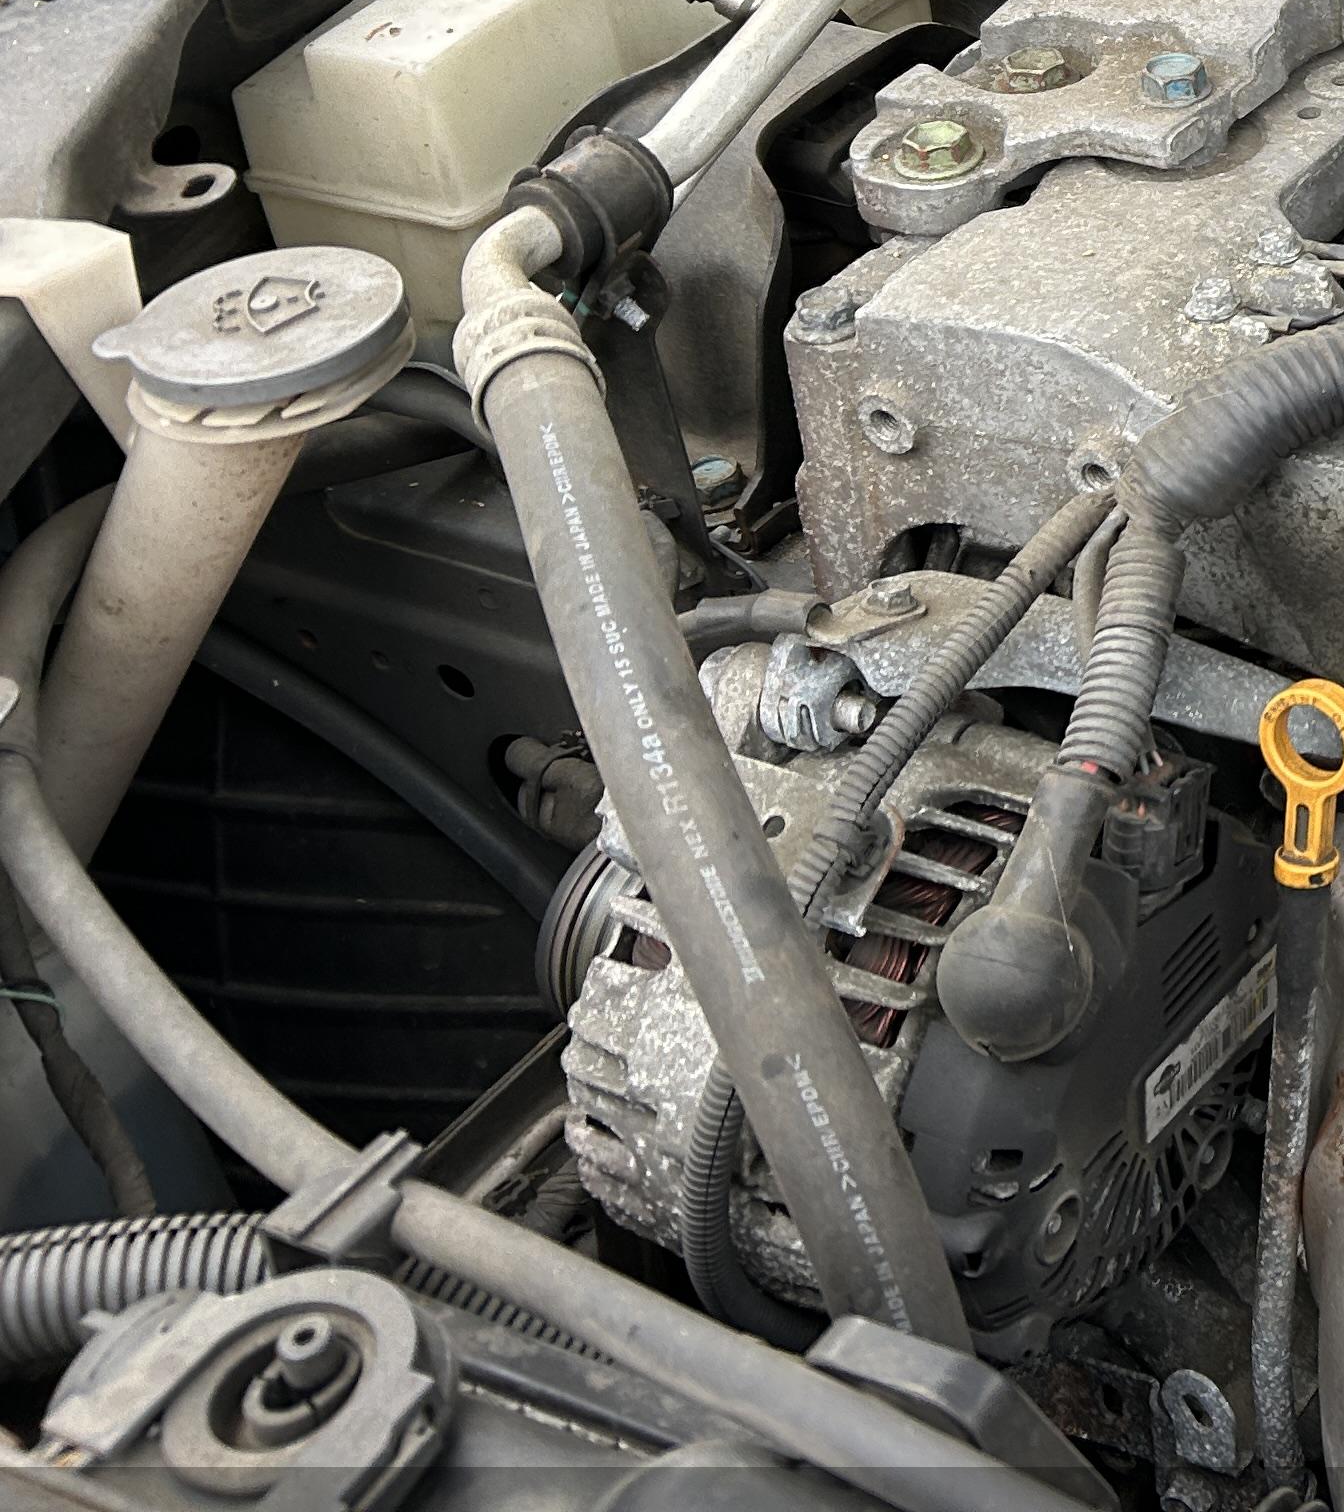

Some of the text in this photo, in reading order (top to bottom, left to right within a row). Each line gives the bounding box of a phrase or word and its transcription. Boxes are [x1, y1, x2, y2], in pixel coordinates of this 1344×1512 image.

[563, 505, 591, 552] JAPAN
[578, 552, 595, 570] IN
[584, 571, 611, 617] MADE
[600, 618, 626, 654] SUC
[614, 657, 633, 678] 15
[622, 680, 653, 731] ONLY
[635, 730, 690, 816] R134a
[678, 816, 709, 860] NEX
[846, 1193, 885, 1258] JAPAN
[873, 1260, 893, 1283] IN
